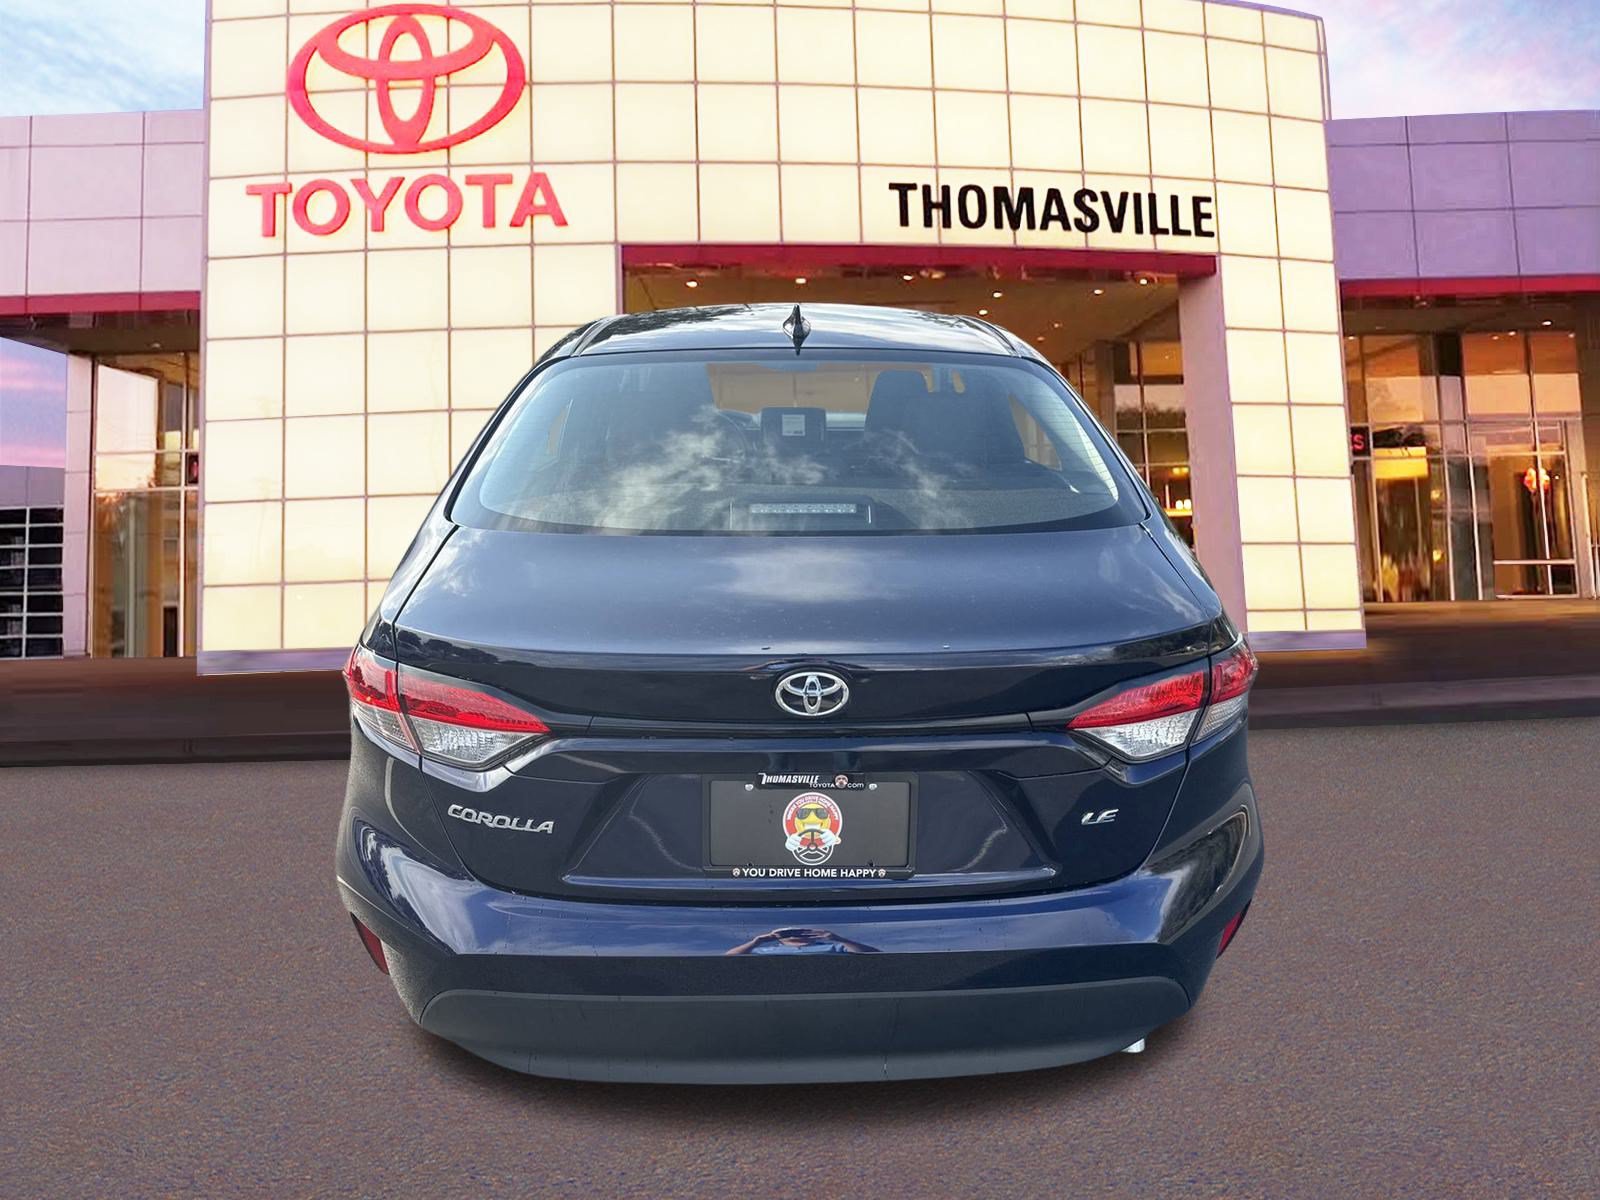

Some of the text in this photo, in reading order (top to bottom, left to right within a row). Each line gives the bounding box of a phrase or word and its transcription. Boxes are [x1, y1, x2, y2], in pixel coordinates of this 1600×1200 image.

[246, 172, 568, 237] TOYOTA
[888, 182, 1216, 238] THOMASVILLE
[758, 772, 819, 784] THOMASVILLE
[447, 803, 554, 834] COROLLA
[1081, 808, 1119, 825] LE
[742, 868, 877, 878] YOU DRIVE HOME HAPPY
